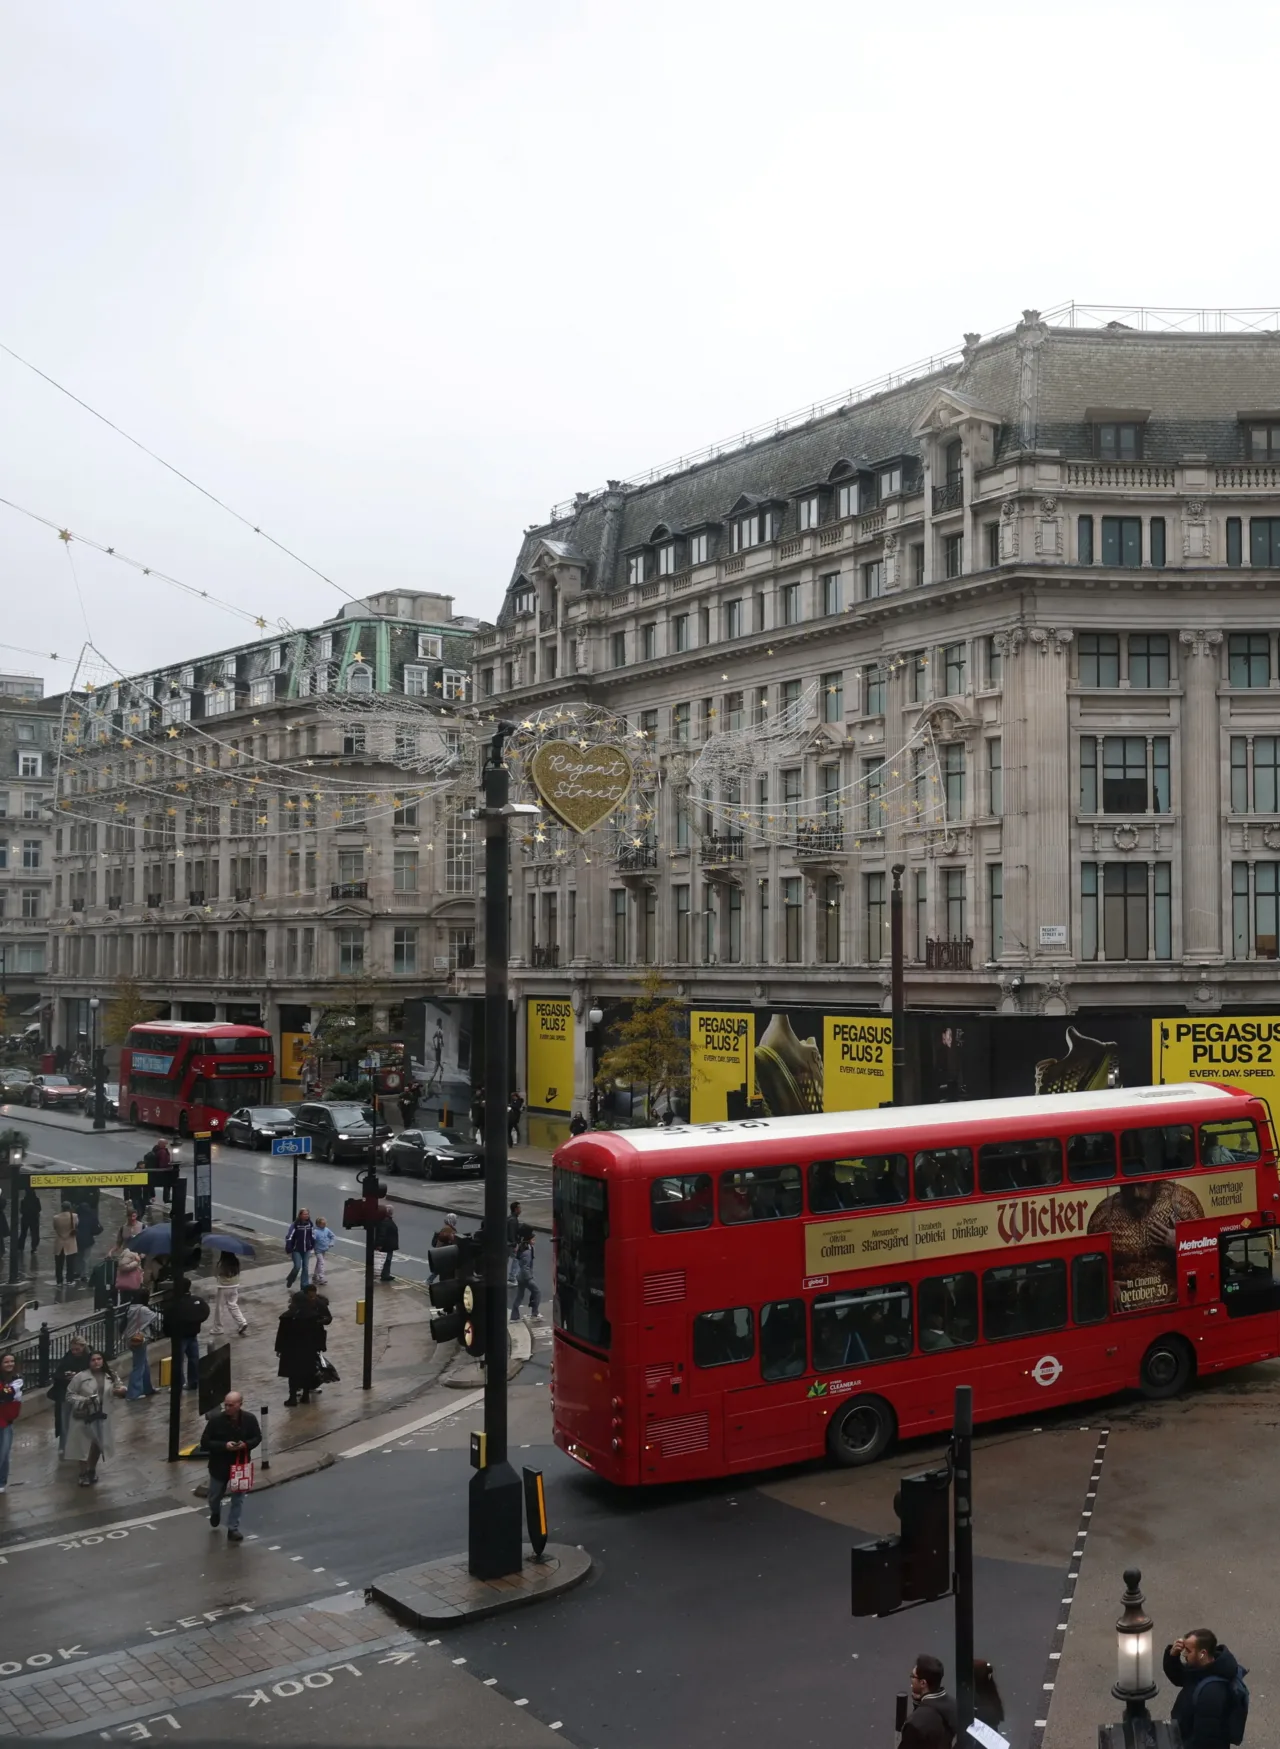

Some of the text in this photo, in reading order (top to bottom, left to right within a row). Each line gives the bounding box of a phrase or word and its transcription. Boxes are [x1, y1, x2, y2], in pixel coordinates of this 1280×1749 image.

[549, 755, 625, 781] Regent
[554, 781, 622, 800] Street
[536, 1003, 571, 1017] PEGASUS
[541, 1017, 566, 1031] PLUS 2
[833, 1024, 892, 1044] PEGASUS
[705, 1035, 739, 1052] PLUS 2
[842, 1043, 883, 1063] PLUS 2
[1193, 1044, 1272, 1063] PLUS 2
[1222, 1069, 1241, 1077] DAY.
[1243, 1069, 1275, 1077] SPEED.
[32, 1175, 134, 1185] BE SLIPPERY WHEN WET
[1209, 1180, 1243, 1194] Marriage
[1211, 1193, 1242, 1207] Material
[918, 1221, 942, 1231] Elizabeth
[963, 1217, 977, 1225] Peter
[997, 1197, 1089, 1244] Wicker
[872, 1227, 899, 1238] Alexander
[915, 1230, 946, 1245] Debicki
[952, 1224, 989, 1240] Dinklage
[821, 1243, 855, 1258] Colman
[861, 1234, 909, 1253] Skarsgård
[1178, 1237, 1217, 1251] Metroline
[1156, 1283, 1169, 1296] 30
[57, 1524, 158, 1550] LOOK
[0, 1601, 256, 1675] OOK LEFT
[232, 1663, 362, 1707] LOOK
